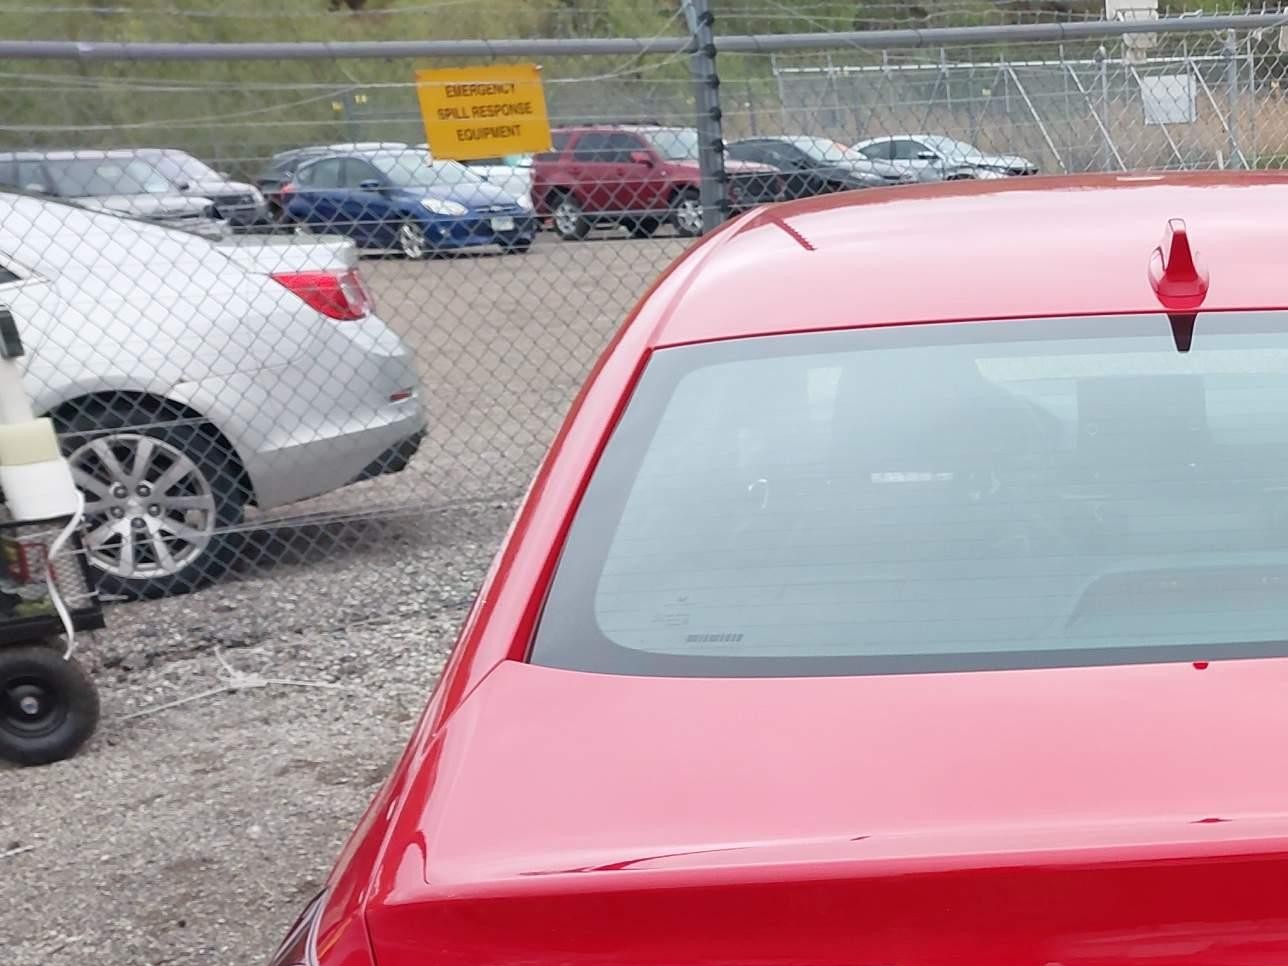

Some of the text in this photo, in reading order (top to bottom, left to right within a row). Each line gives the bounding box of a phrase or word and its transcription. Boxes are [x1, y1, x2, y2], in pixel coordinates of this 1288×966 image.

[444, 83, 515, 98] EMERGENCY
[437, 102, 533, 120] SPILL RESPONSE
[456, 124, 521, 141] EQUIPMENT
